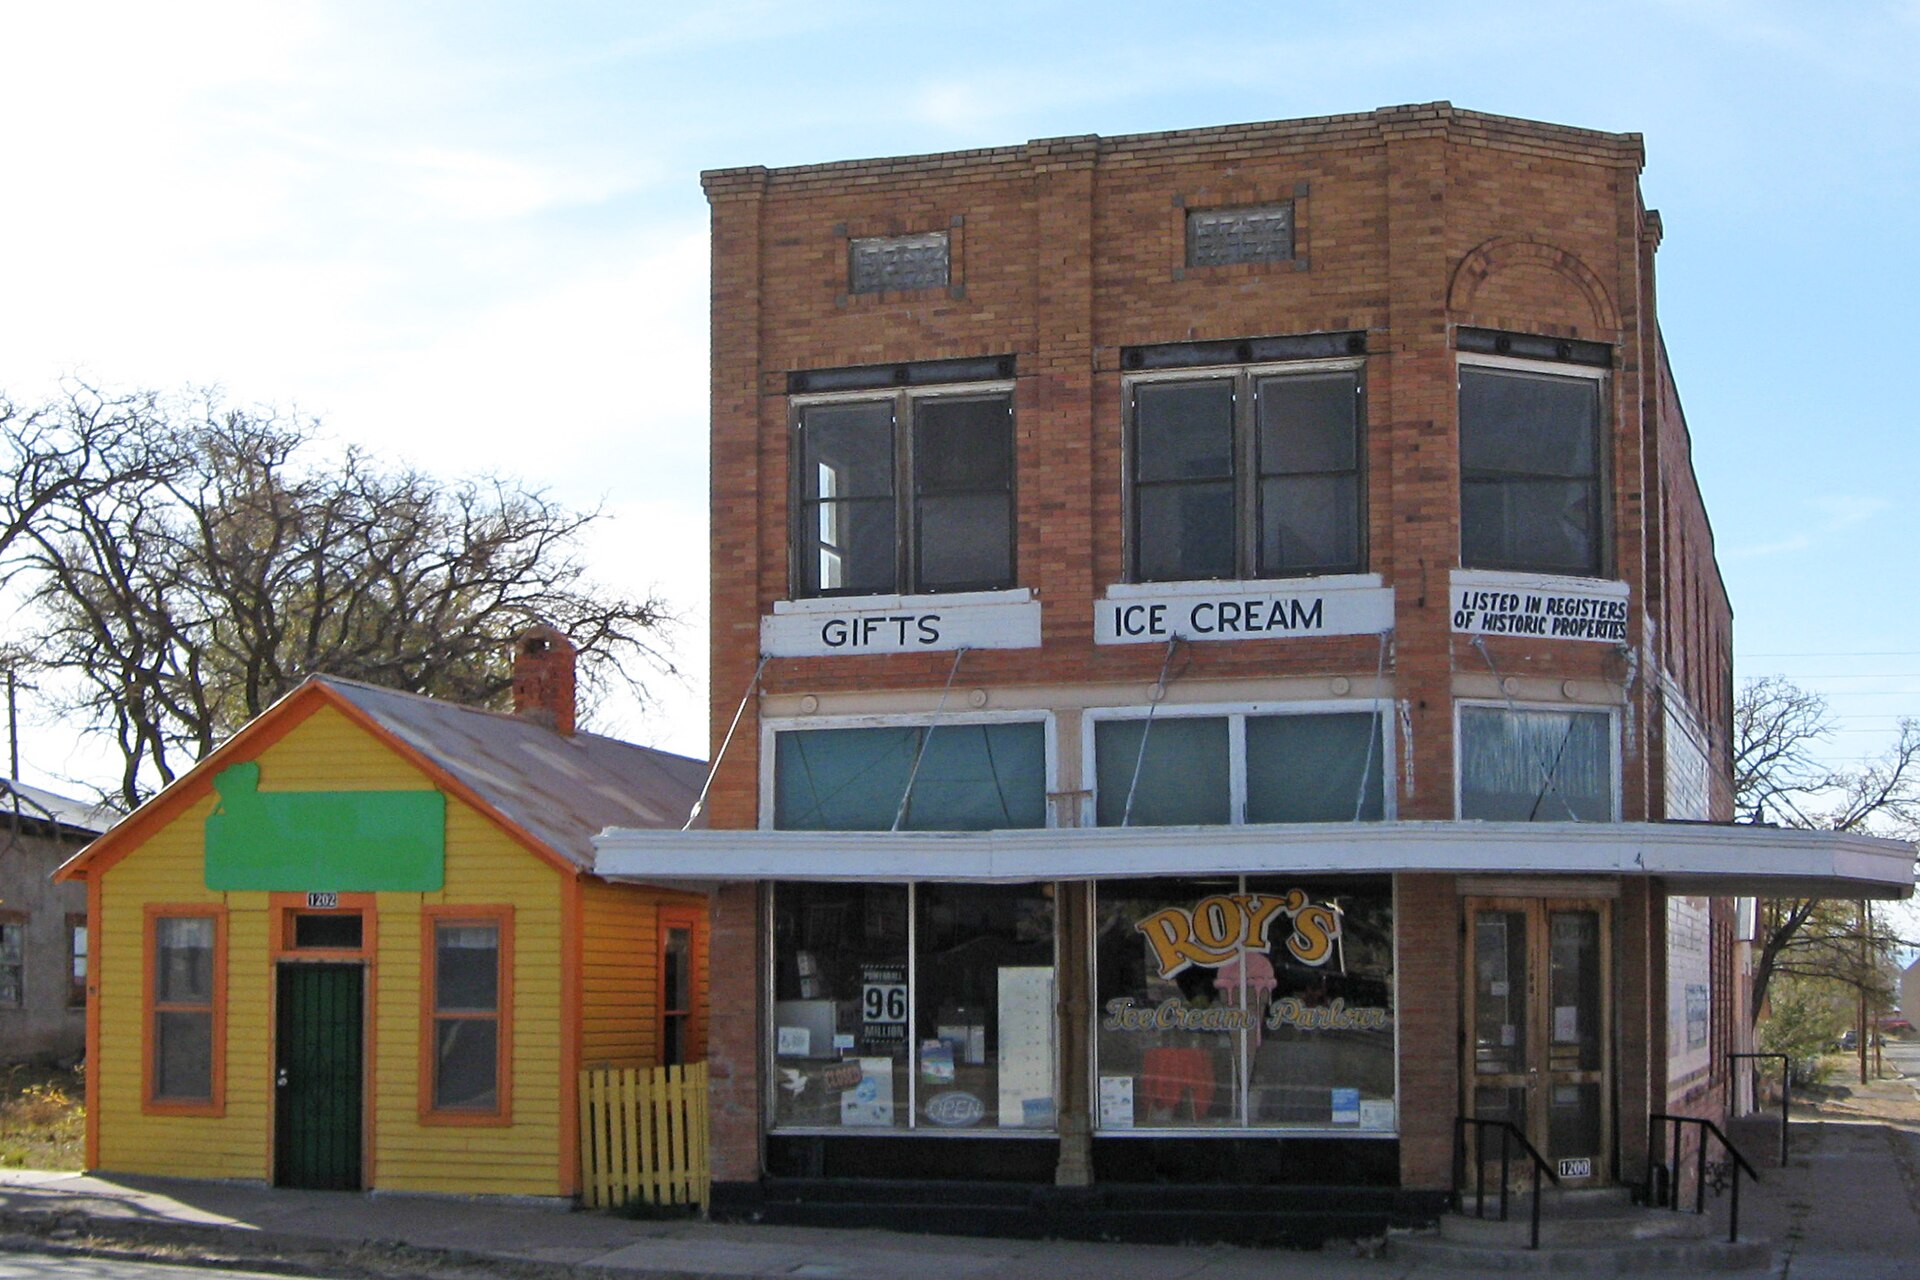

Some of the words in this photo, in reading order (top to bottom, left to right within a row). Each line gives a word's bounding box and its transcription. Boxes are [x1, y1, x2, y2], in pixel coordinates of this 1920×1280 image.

[1115, 604, 1167, 637] ICE
[1190, 598, 1323, 633] CREAM
[1462, 591, 1519, 613] LISTED
[1525, 595, 1541, 614] IN
[1546, 597, 1627, 621] REGISTERS
[821, 614, 941, 647] GIFTS
[1454, 610, 1475, 629] OF
[1481, 612, 1548, 635] HISTORIC
[1552, 617, 1627, 640] PROPERTIES
[309, 893, 336, 907] 1202
[1135, 888, 1343, 981] ROY'S
[865, 987, 905, 1020] 96
[1104, 997, 1152, 1031] Ice
[1153, 997, 1257, 1031] Cream
[1266, 997, 1391, 1031] Parlour
[928, 1099, 981, 1119] OPEN
[1561, 1160, 1588, 1176] 1200
